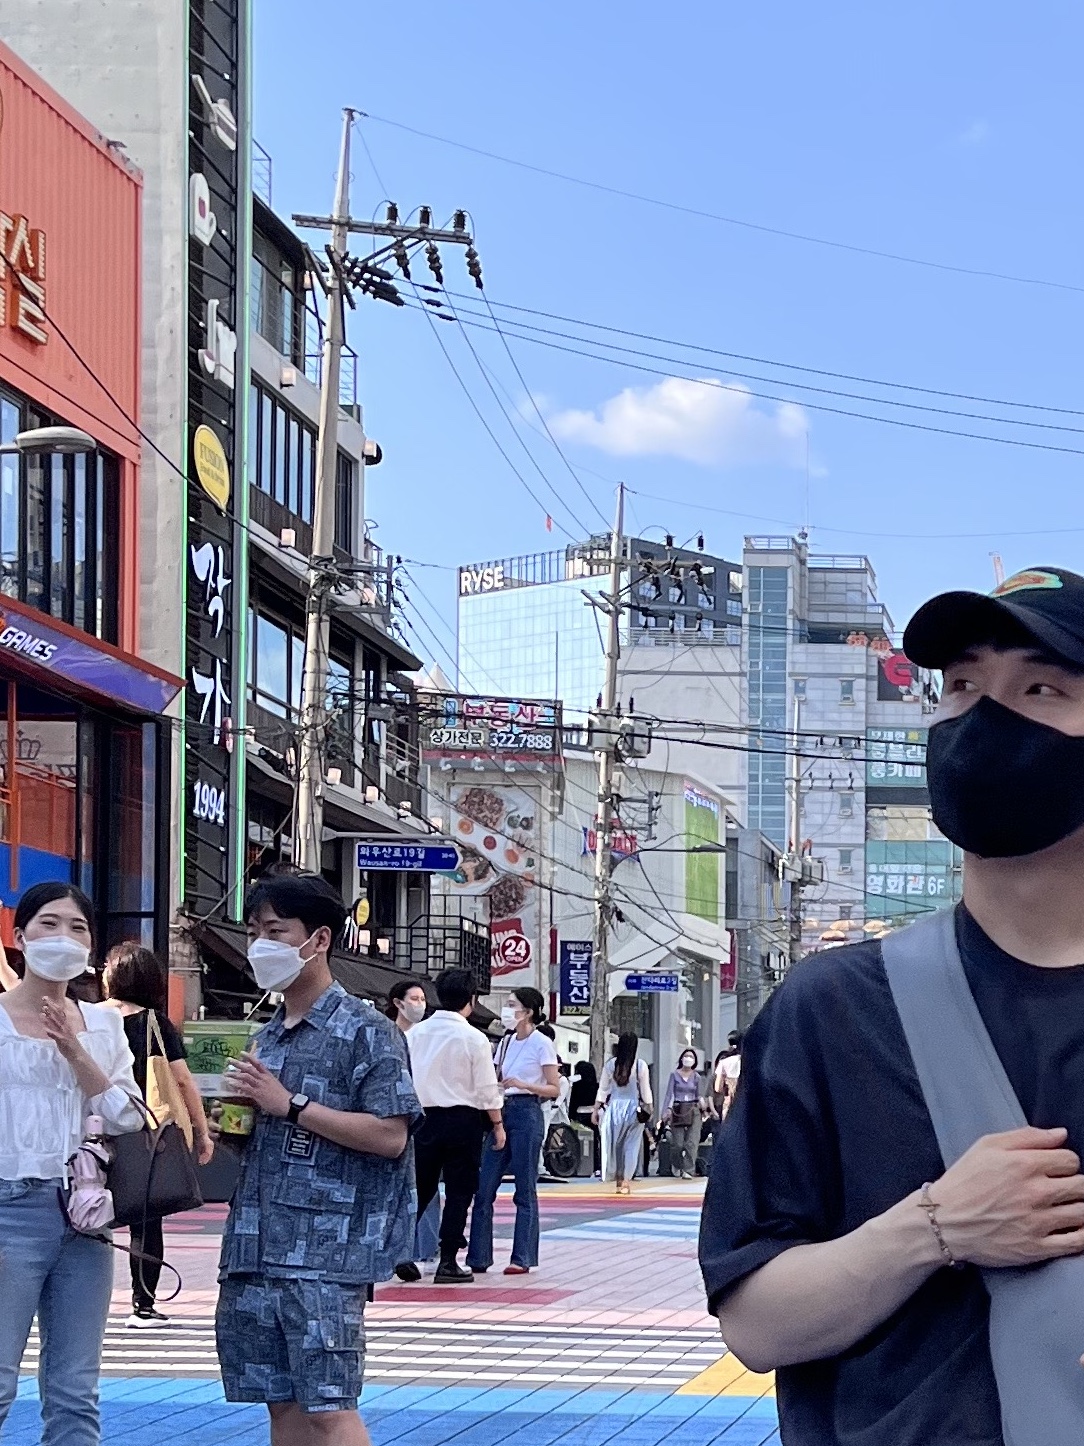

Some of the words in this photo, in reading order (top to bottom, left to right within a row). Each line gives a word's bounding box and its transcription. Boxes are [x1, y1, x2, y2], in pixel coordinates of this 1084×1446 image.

[461, 565, 504, 594] RYSE
[0, 626, 58, 661] GAMES
[430, 728, 485, 746] 상가전문
[192, 780, 226, 827] 1994
[359, 846, 426, 860] 와우산로19길
[866, 873, 926, 895] 영화관
[927, 875, 946, 896] 6F
[504, 938, 528, 957] 24
[568, 952, 590, 1004] 부동산
